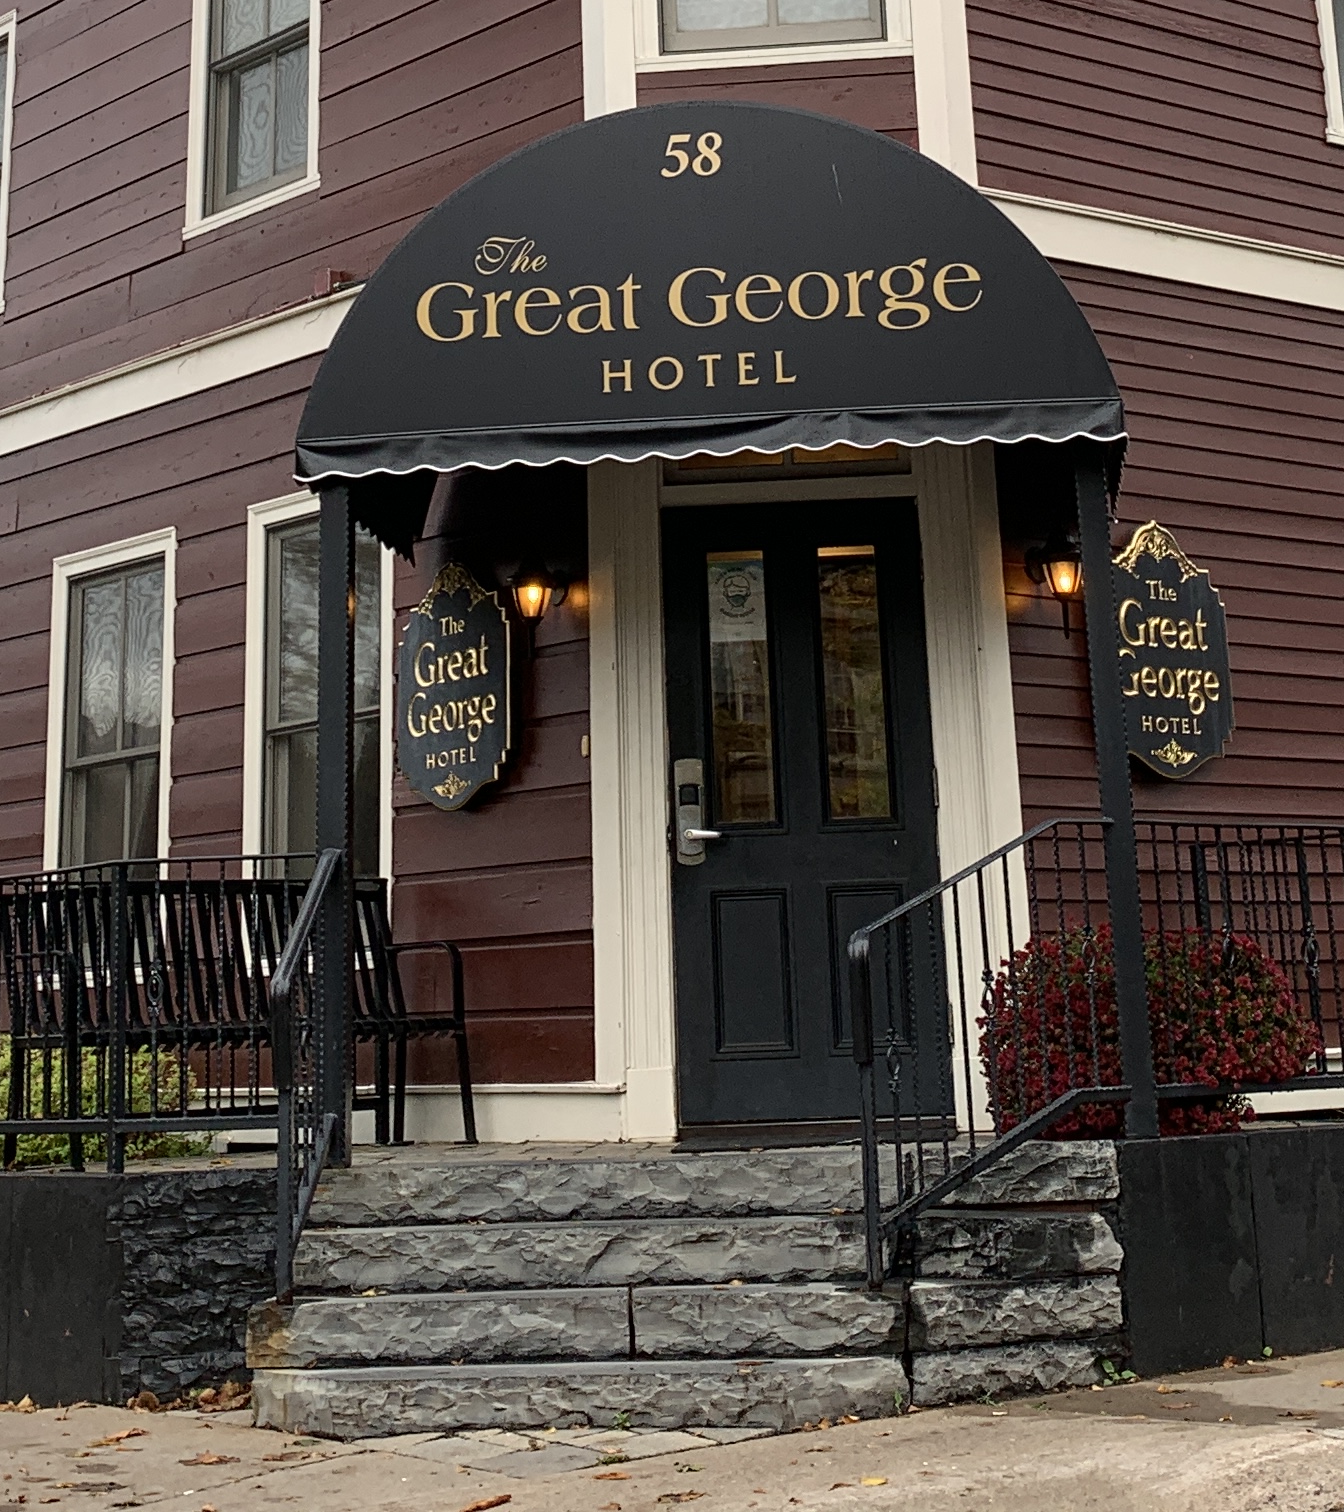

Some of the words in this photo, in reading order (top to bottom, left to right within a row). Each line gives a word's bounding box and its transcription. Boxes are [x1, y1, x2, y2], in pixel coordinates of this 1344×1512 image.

[660, 131, 723, 178] 58
[475, 236, 548, 275] The
[415, 273, 642, 342] Great
[668, 257, 983, 331] George
[601, 350, 798, 394] HOTEL
[1145, 579, 1178, 602] The
[439, 615, 466, 637] The
[1118, 597, 1209, 652] Great
[414, 632, 490, 688] Great
[407, 692, 497, 743] George
[1142, 715, 1202, 735] HOTEL
[425, 746, 477, 769] HOTEL
